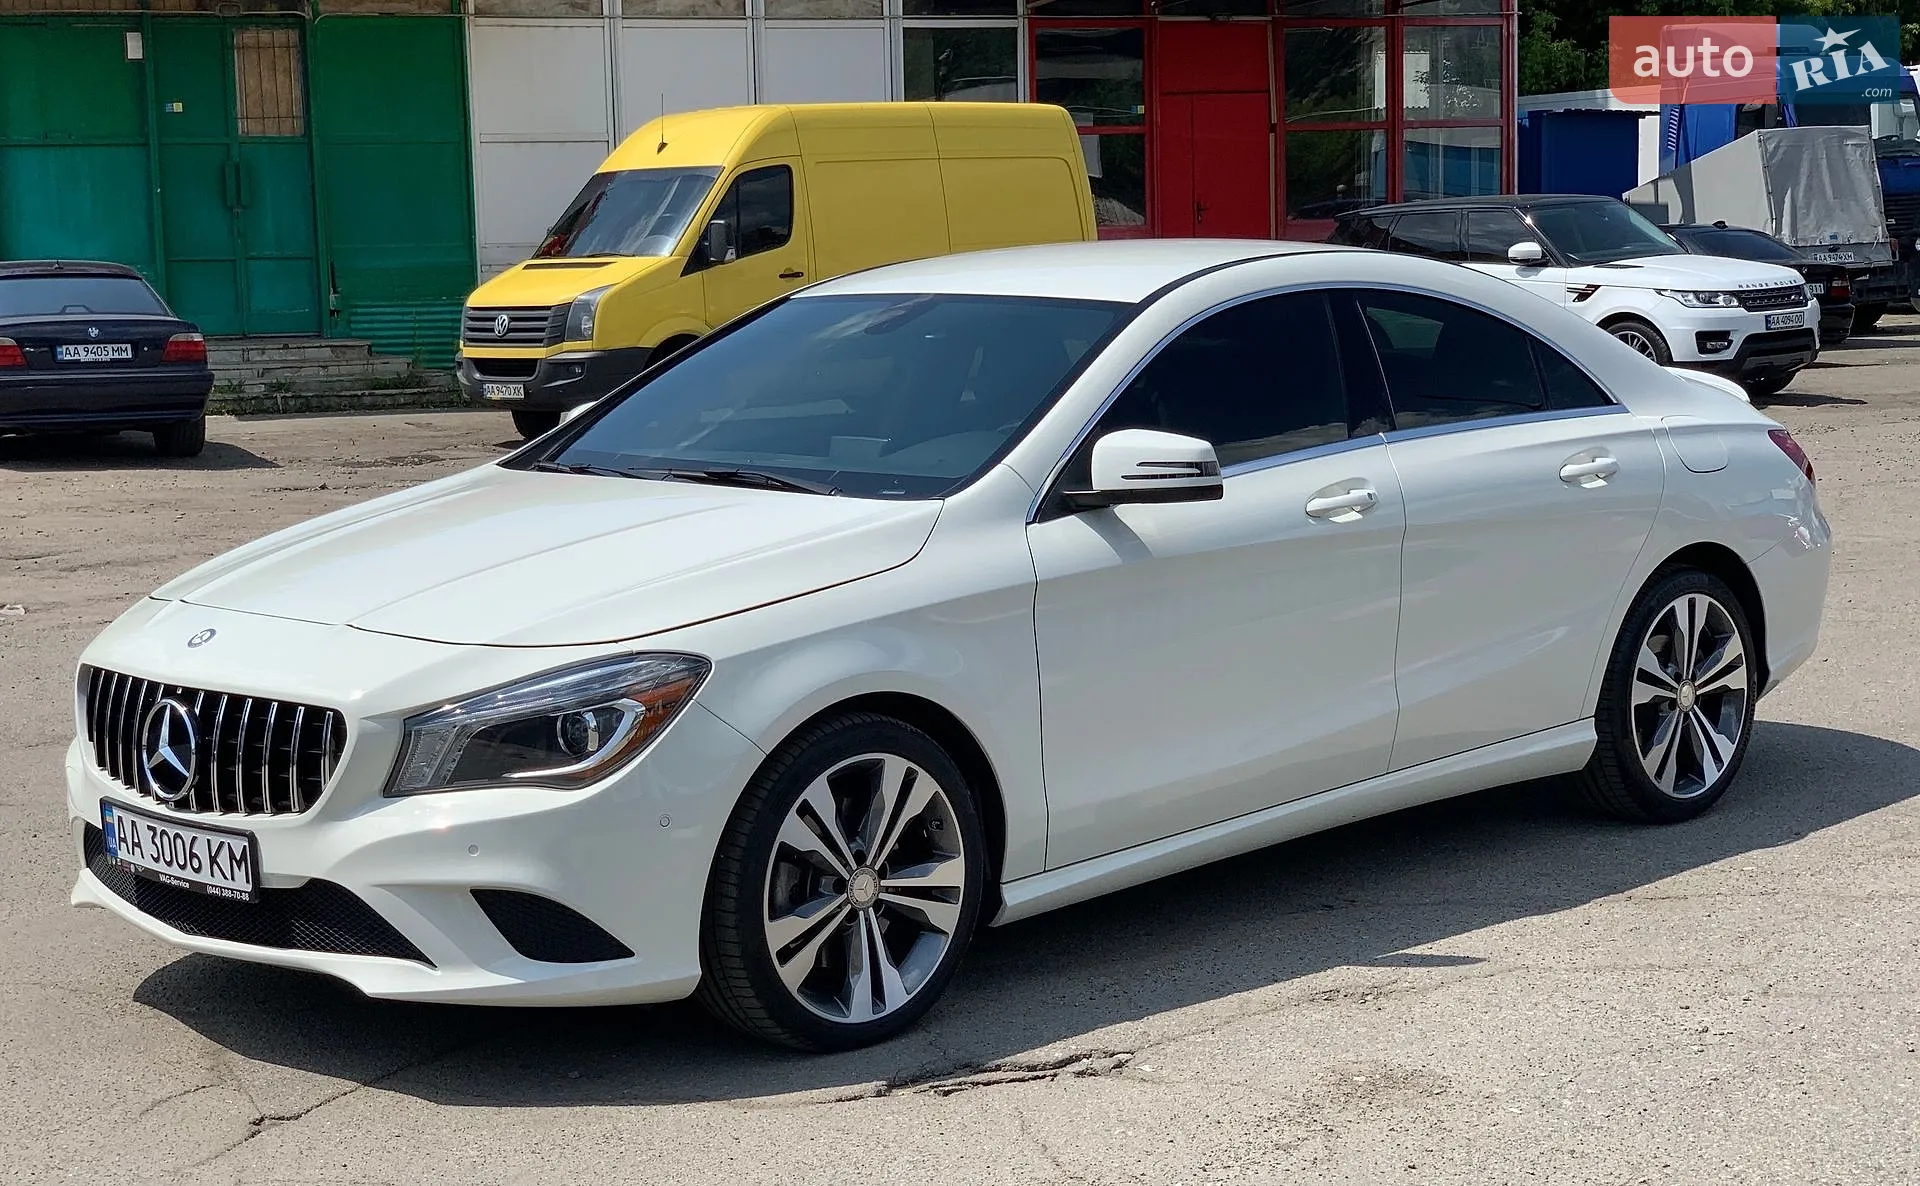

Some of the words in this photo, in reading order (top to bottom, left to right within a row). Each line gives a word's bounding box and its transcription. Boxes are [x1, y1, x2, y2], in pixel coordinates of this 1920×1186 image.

[1771, 316, 1781, 326] AA
[64, 347, 81, 358] AA
[83, 346, 109, 357] 9405
[111, 346, 129, 357] MM
[512, 386, 523, 396] XK
[117, 815, 144, 859] AA
[147, 824, 202, 874] 3006
[207, 837, 250, 884] KM
[159, 873, 190, 889] VAG-Service
